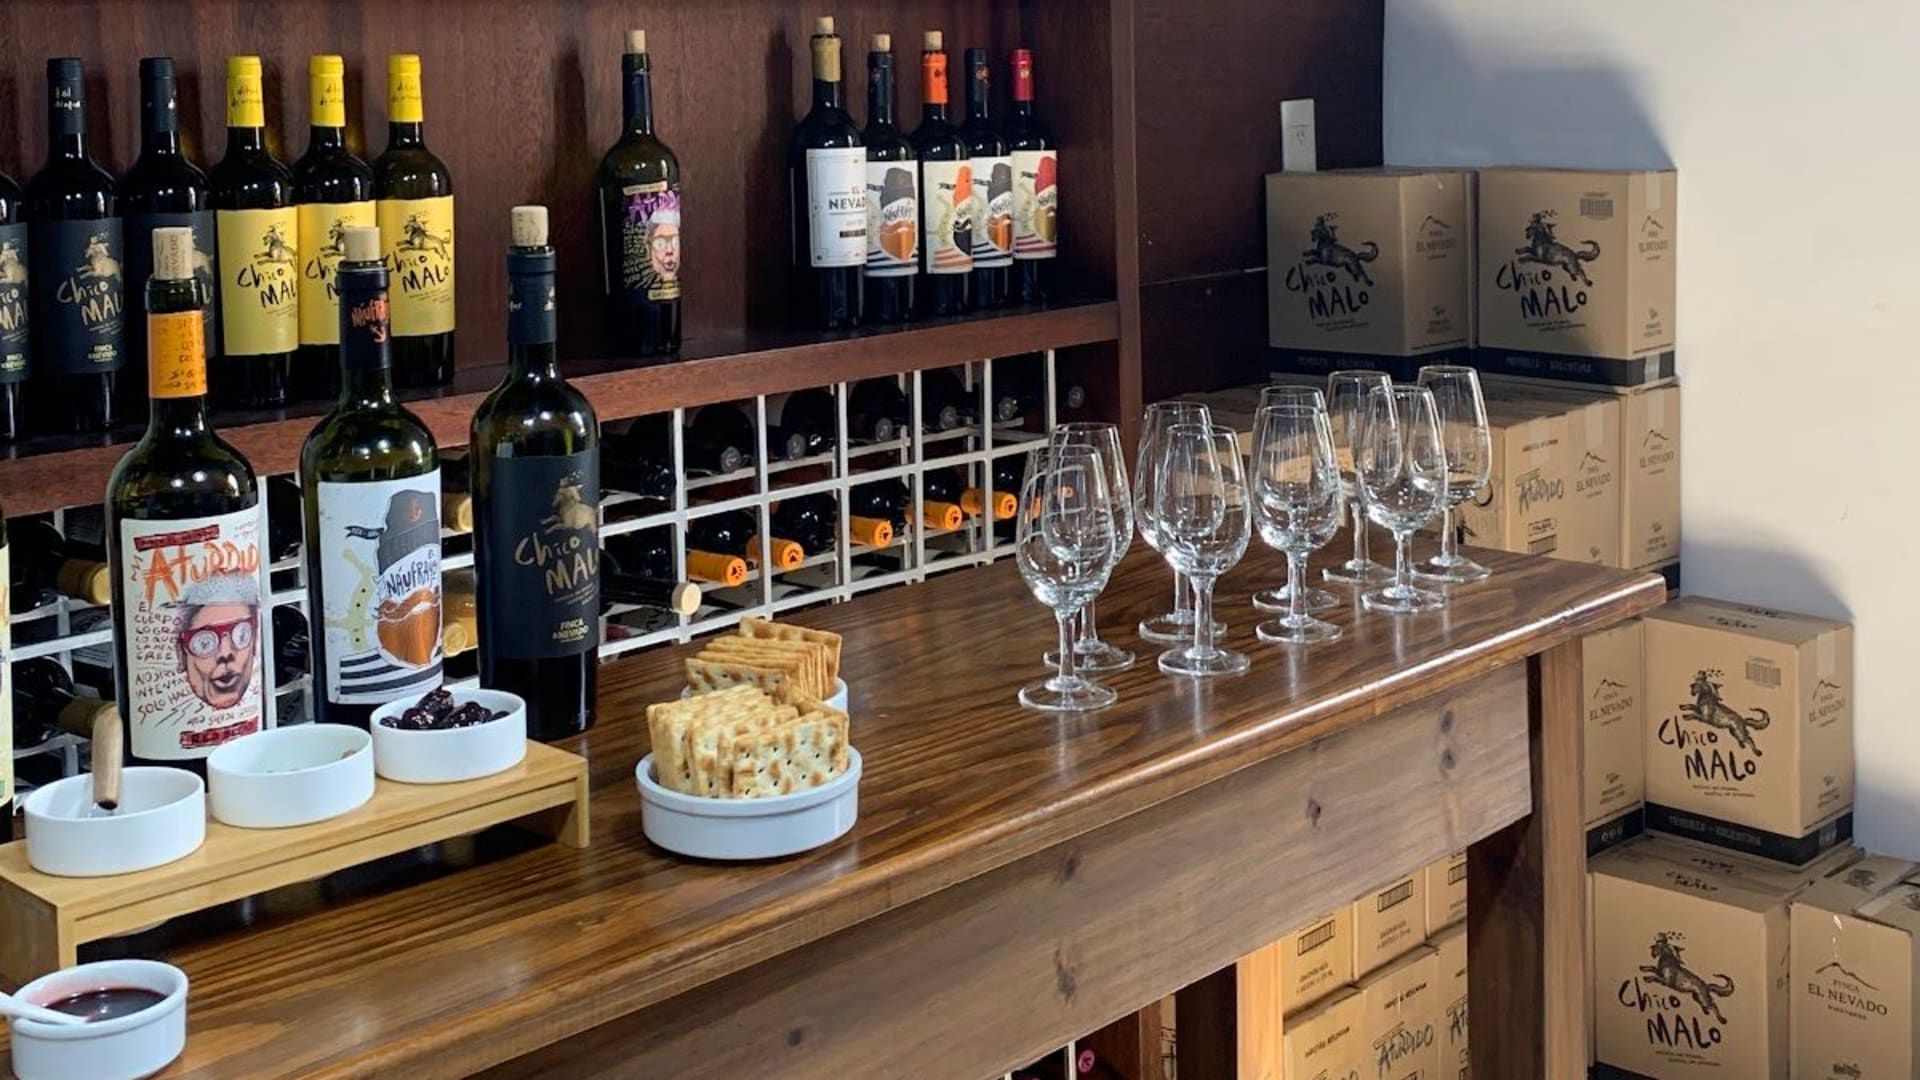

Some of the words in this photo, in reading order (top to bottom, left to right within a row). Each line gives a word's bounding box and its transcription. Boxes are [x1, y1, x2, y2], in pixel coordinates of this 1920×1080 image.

[828, 196, 865, 211] NEVA
[57, 277, 109, 304] Chico
[237, 263, 284, 288] Chico
[1286, 263, 1337, 293] Chico
[1496, 261, 1552, 292] Chico
[81, 293, 124, 326] MAL
[260, 281, 298, 309] MAL
[514, 531, 580, 566] Chico
[545, 548, 599, 595] MAL
[1658, 715, 1718, 750] Chico
[1618, 977, 1682, 1013] Chico
[1808, 983, 1825, 998] EL
[1827, 988, 1889, 1016] NEVADO
